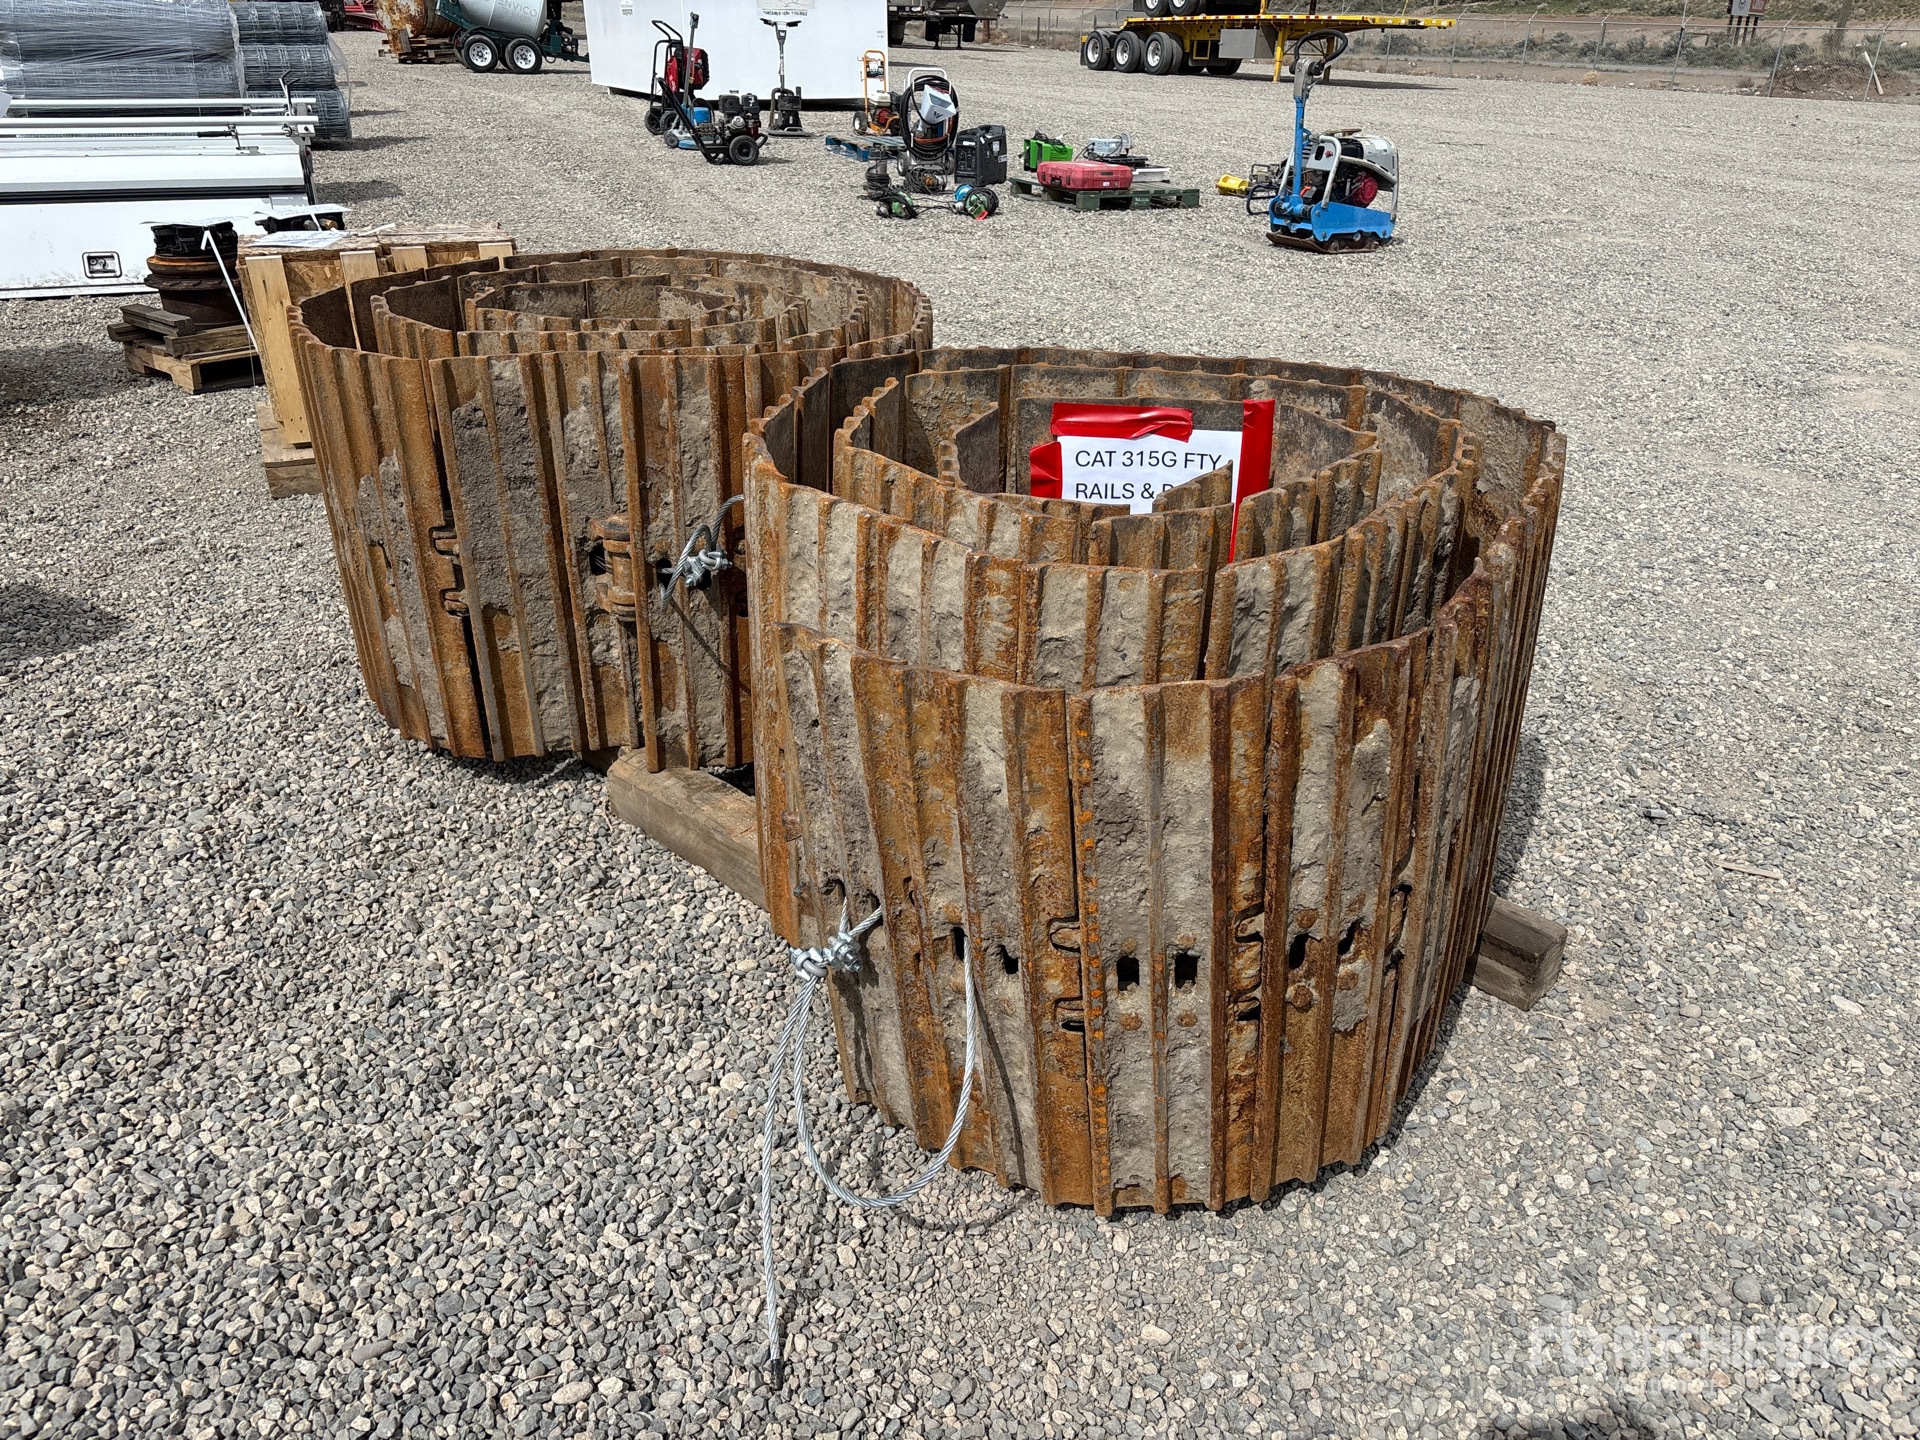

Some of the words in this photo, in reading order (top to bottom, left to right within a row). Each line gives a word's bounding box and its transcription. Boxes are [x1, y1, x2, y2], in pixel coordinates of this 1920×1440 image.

[1075, 450, 1117, 468] CAT
[1121, 450, 1178, 468] 315G
[1183, 452, 1223, 471] FTY
[1075, 483, 1135, 500] RAILS
[1140, 482, 1155, 500] &
